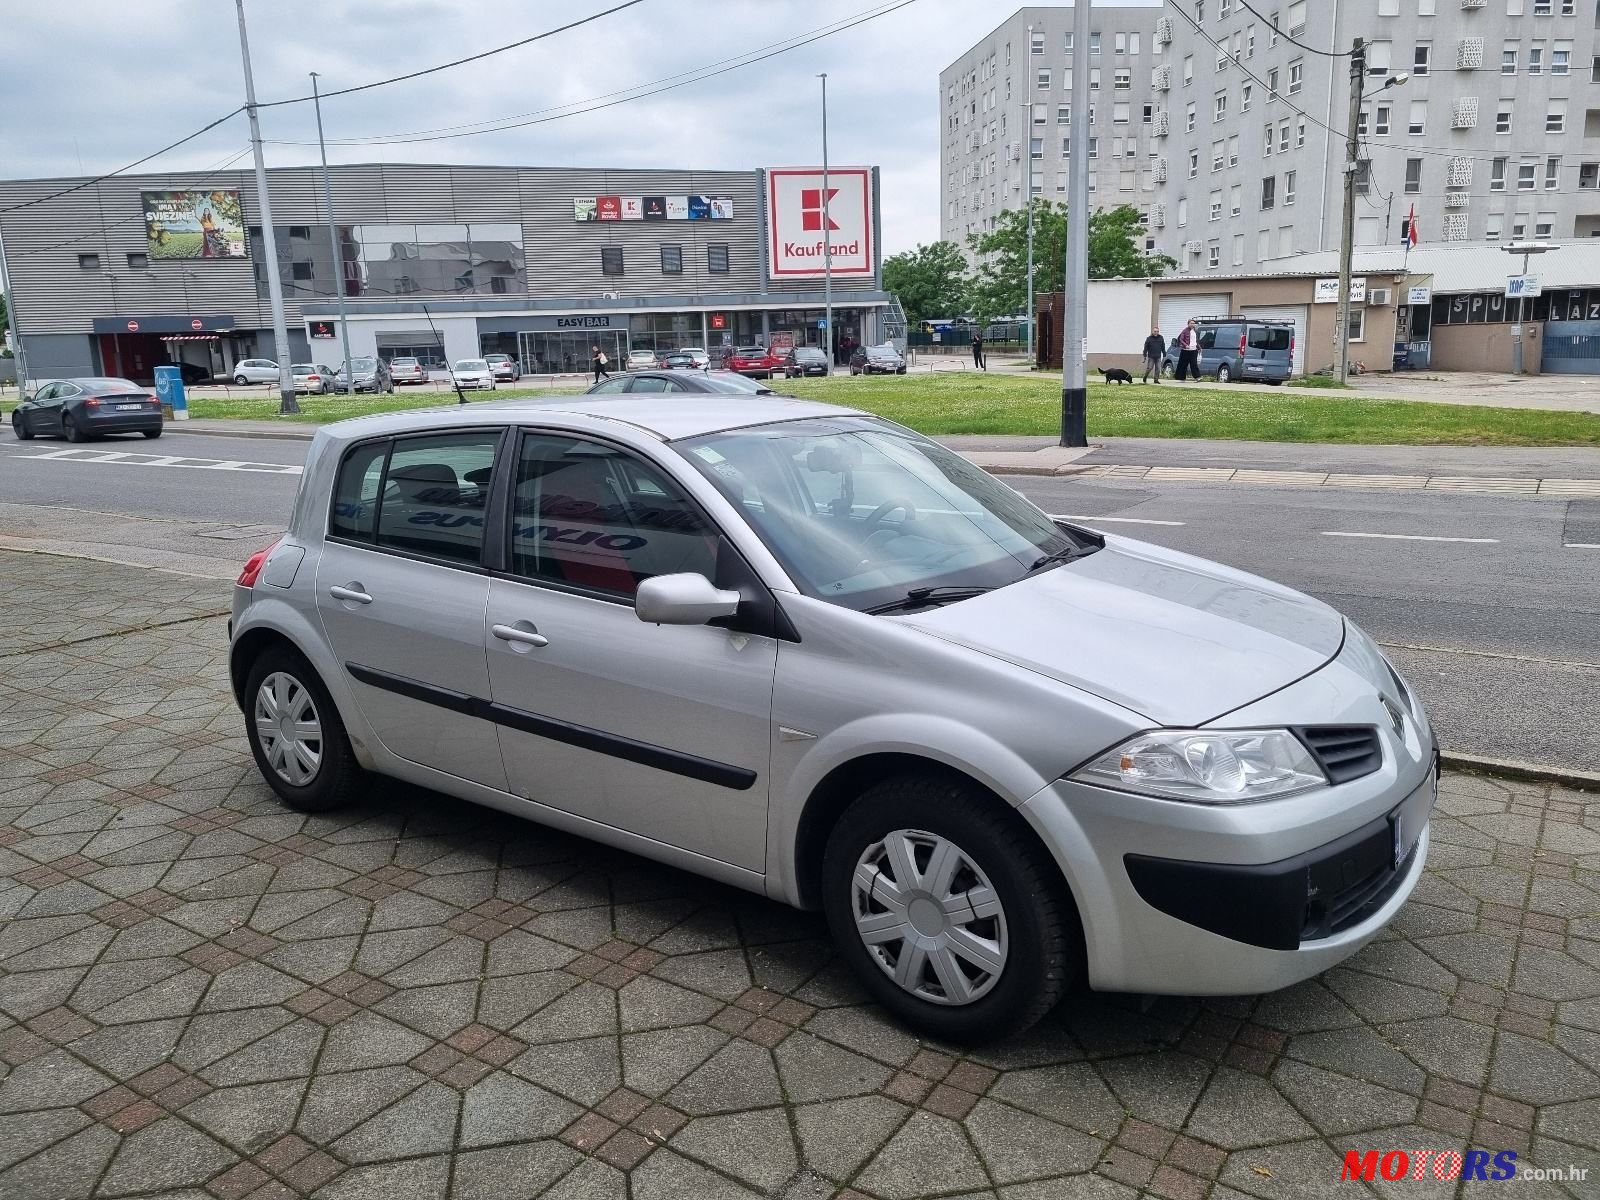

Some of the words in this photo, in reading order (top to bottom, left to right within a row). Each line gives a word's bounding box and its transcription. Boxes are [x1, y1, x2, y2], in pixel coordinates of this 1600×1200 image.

[784, 240, 859, 257] Kaufland
[557, 318, 583, 327] EASY
[585, 317, 609, 327] BAR
